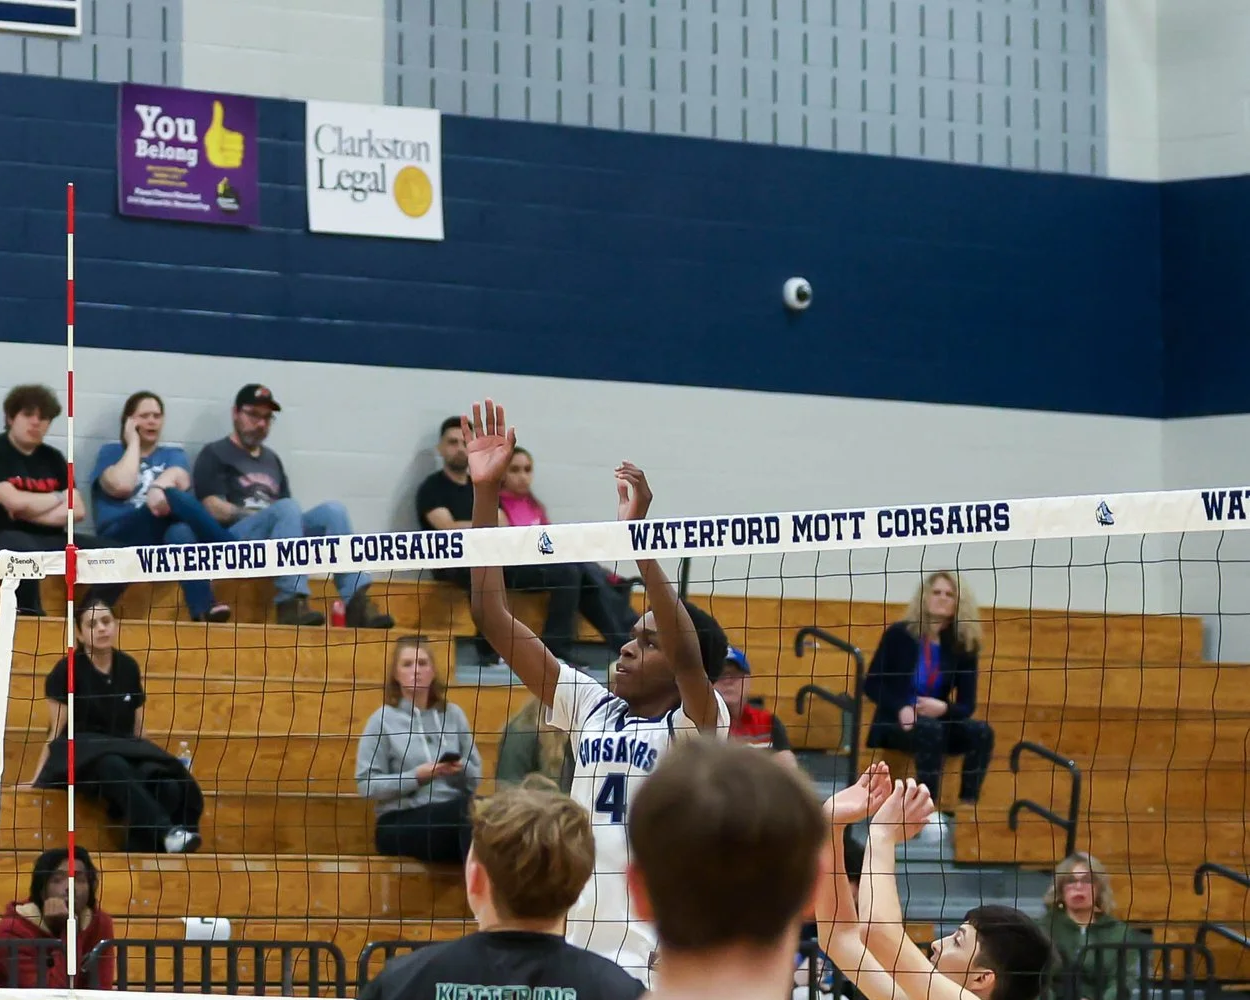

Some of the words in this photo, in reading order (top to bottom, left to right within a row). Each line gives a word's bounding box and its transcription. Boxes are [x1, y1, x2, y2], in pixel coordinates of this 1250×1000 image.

[134, 103, 198, 143] You
[314, 123, 431, 163] Clarkston
[134, 138, 198, 168] Belong
[317, 157, 387, 203] Legal
[1201, 489, 1250, 521] WA
[628, 516, 781, 551] WATERFORD
[792, 511, 866, 543] MOTT
[877, 502, 1010, 538] CORSAIRS
[136, 543, 267, 573] WATERFORD
[276, 537, 341, 567] MOTT
[350, 532, 464, 563] CORSAIRS
[594, 771, 627, 824] 4
